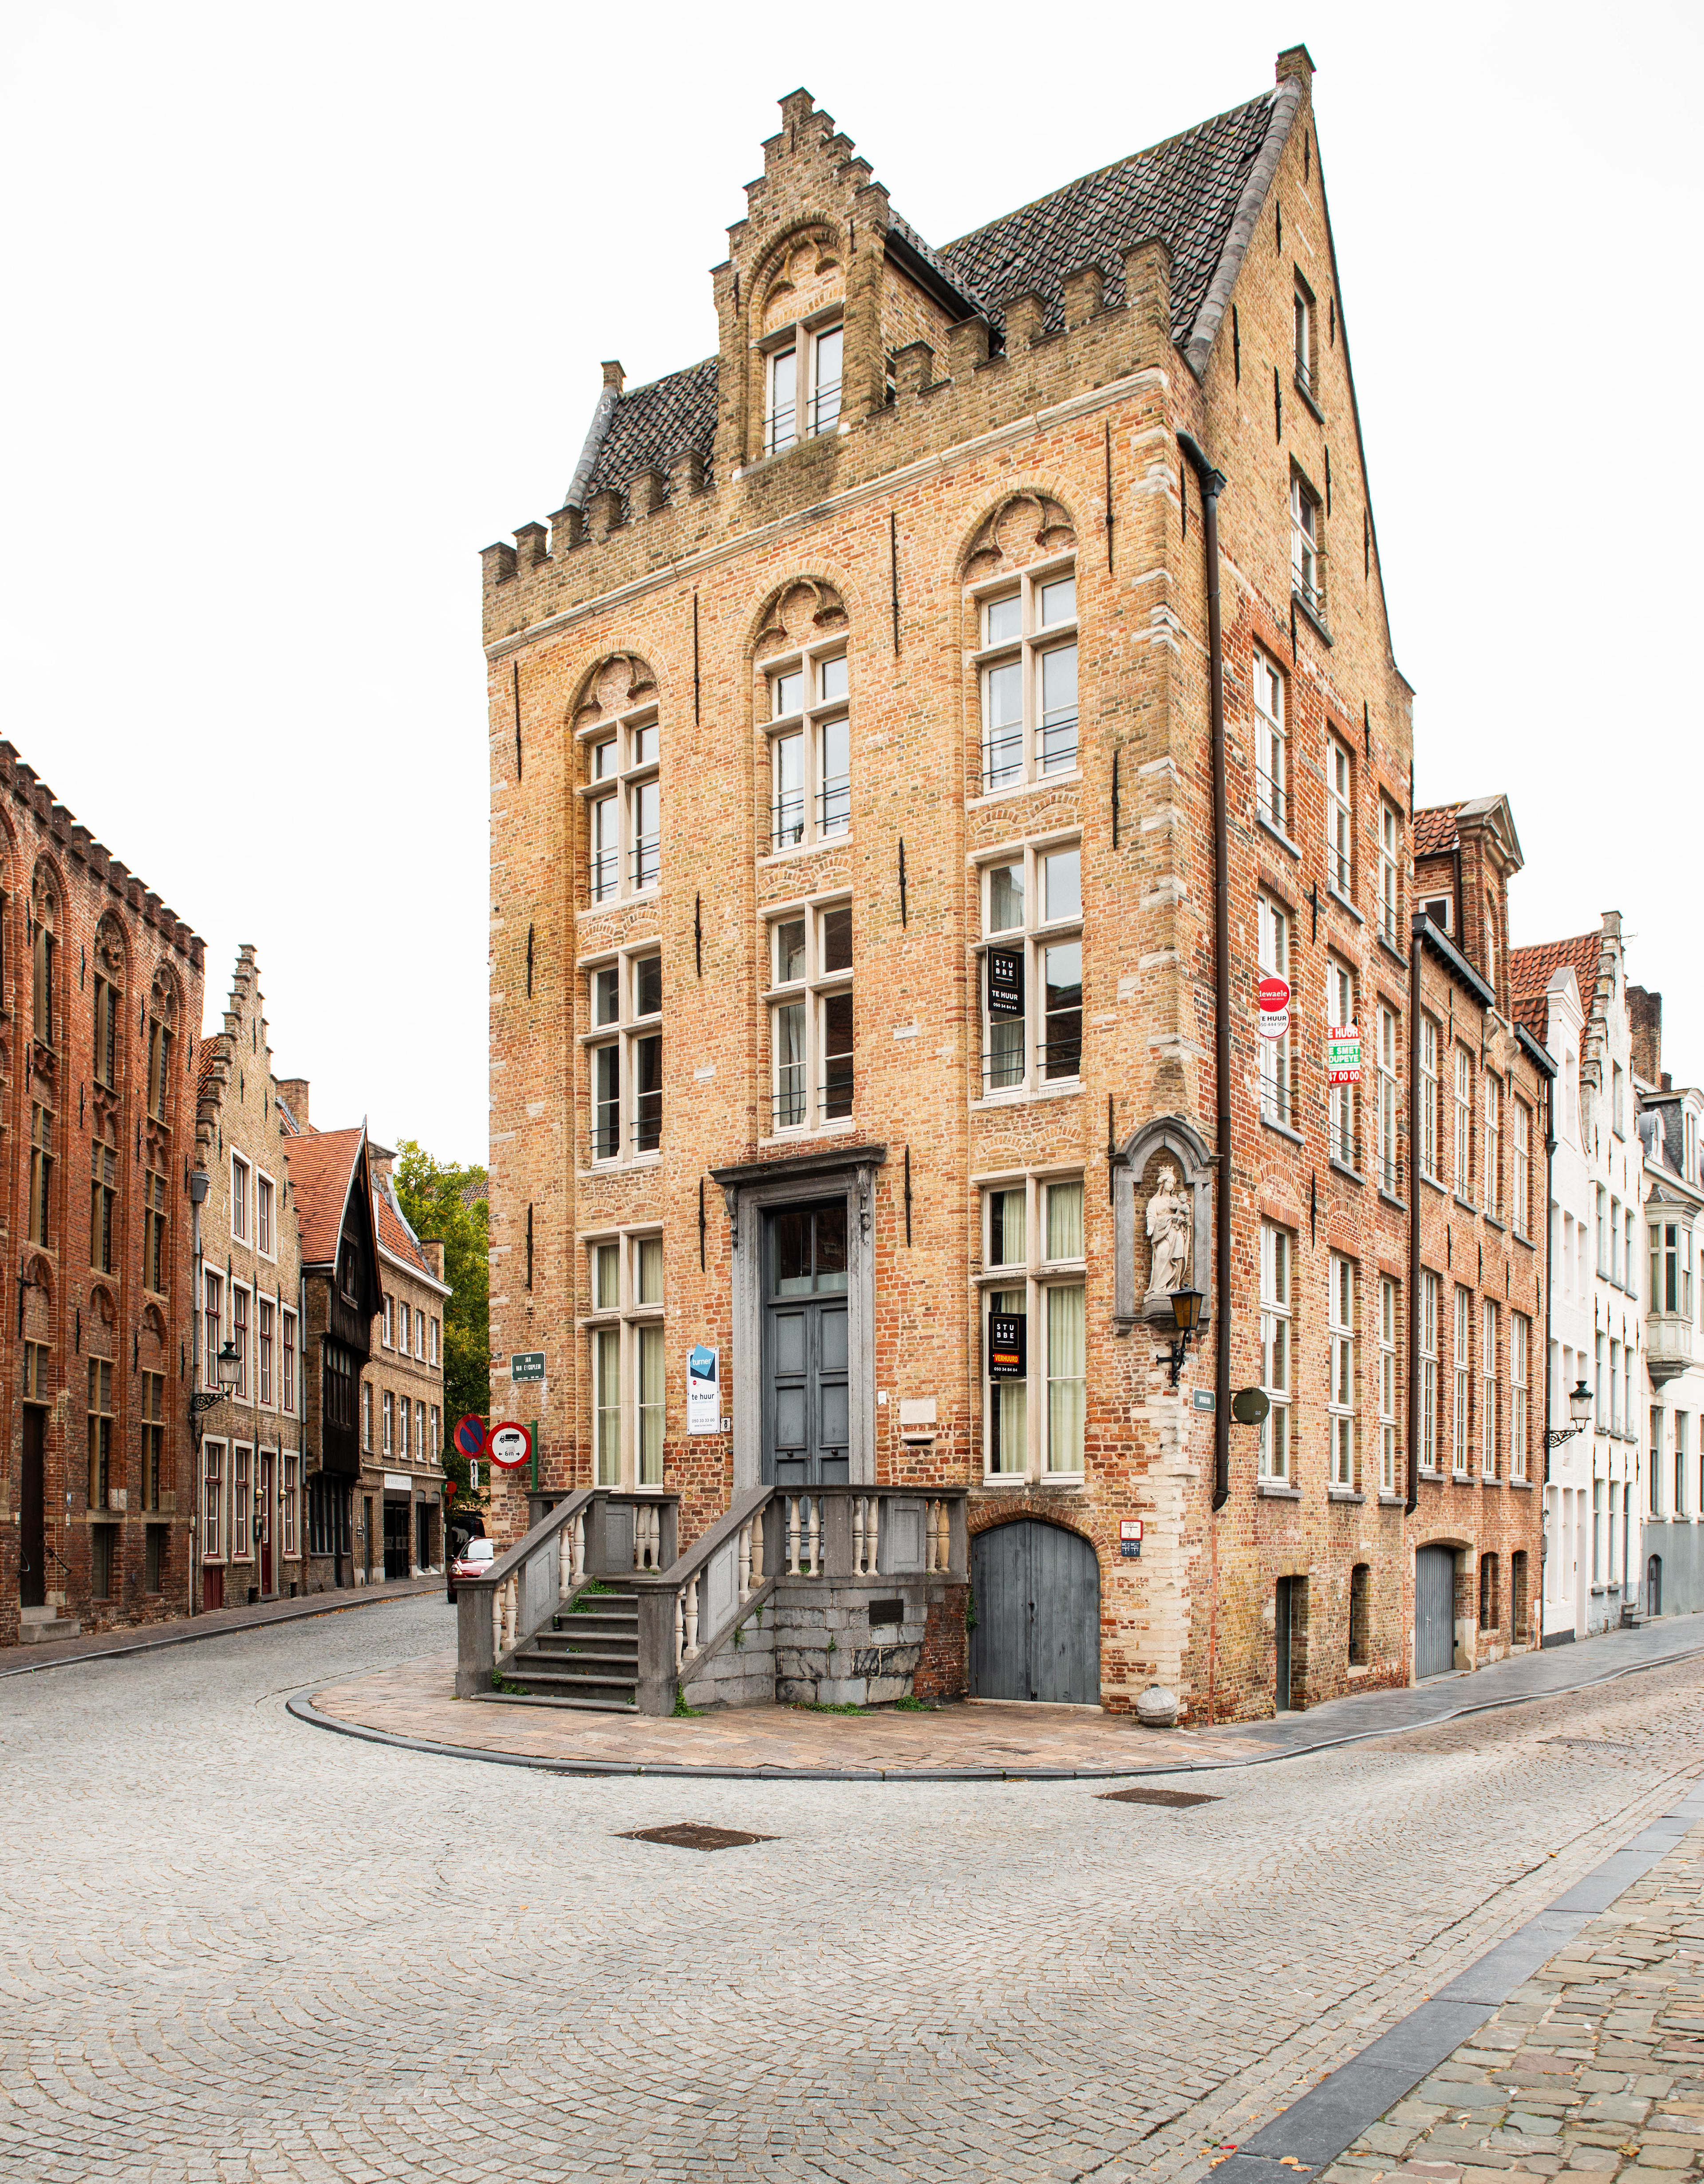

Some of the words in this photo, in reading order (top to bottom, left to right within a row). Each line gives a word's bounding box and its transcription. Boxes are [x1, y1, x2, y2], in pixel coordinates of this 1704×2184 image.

[1001, 991, 1018, 1000] HUUR
[1328, 1028, 1333, 1038] E
[1335, 1027, 1358, 1038] HUUR
[1337, 1046, 1359, 1054] SMET
[1329, 1054, 1359, 1063] OUPEYE
[1338, 1071, 1348, 1081] 00
[1349, 1070, 1359, 1080] 00
[724, 1419, 728, 1428] 8
